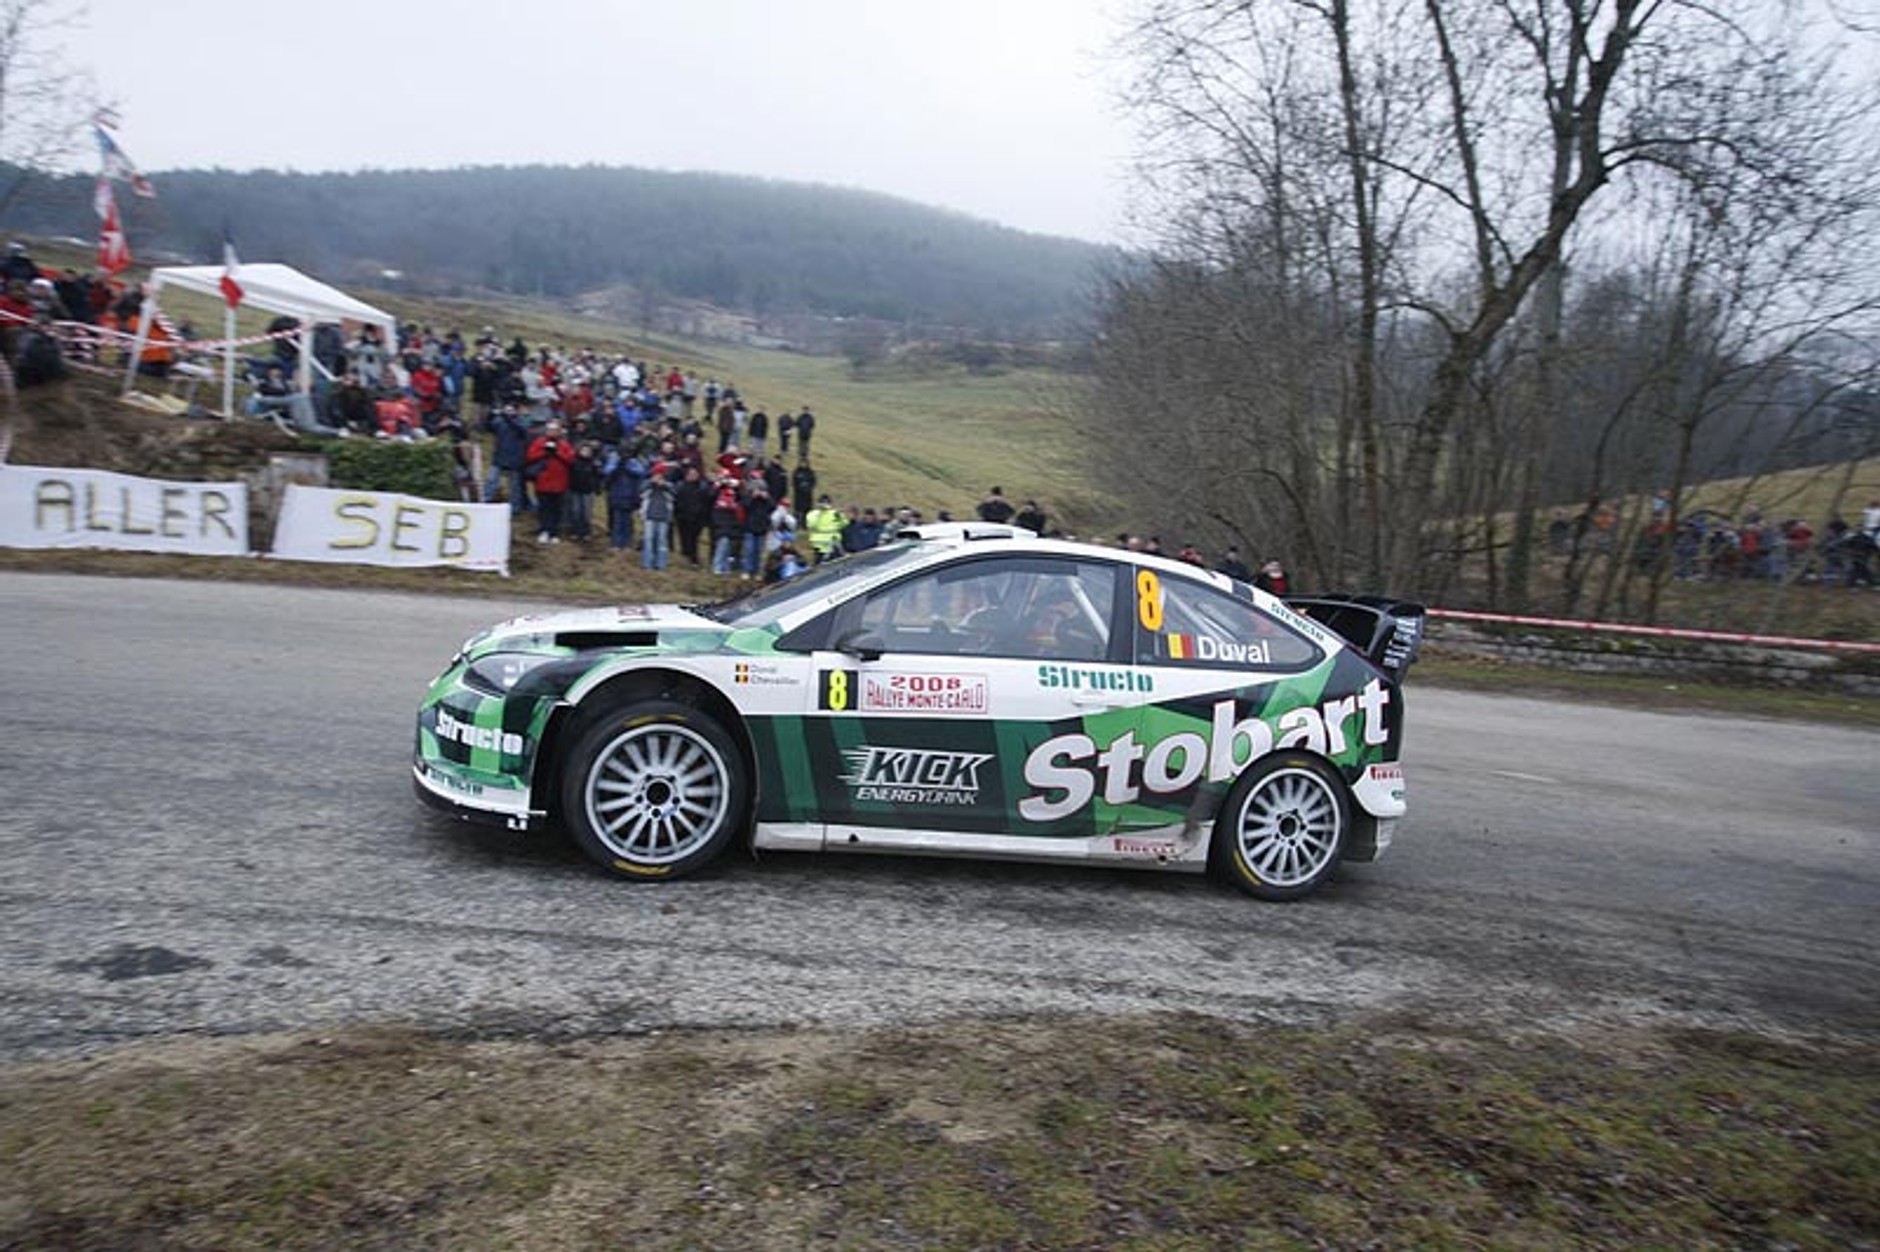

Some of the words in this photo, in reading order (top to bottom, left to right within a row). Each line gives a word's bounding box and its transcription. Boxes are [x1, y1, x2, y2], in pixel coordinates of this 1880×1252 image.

[34, 478, 237, 541] ALLER
[328, 500, 472, 560] SEB
[1136, 568, 1164, 632] 8
[1198, 634, 1271, 664] Duval
[829, 667, 848, 711] 8
[866, 678, 903, 708] RALLYE
[890, 675, 961, 692] 2008
[860, 748, 990, 790] KICK
[1018, 676, 1390, 822] Stobart
